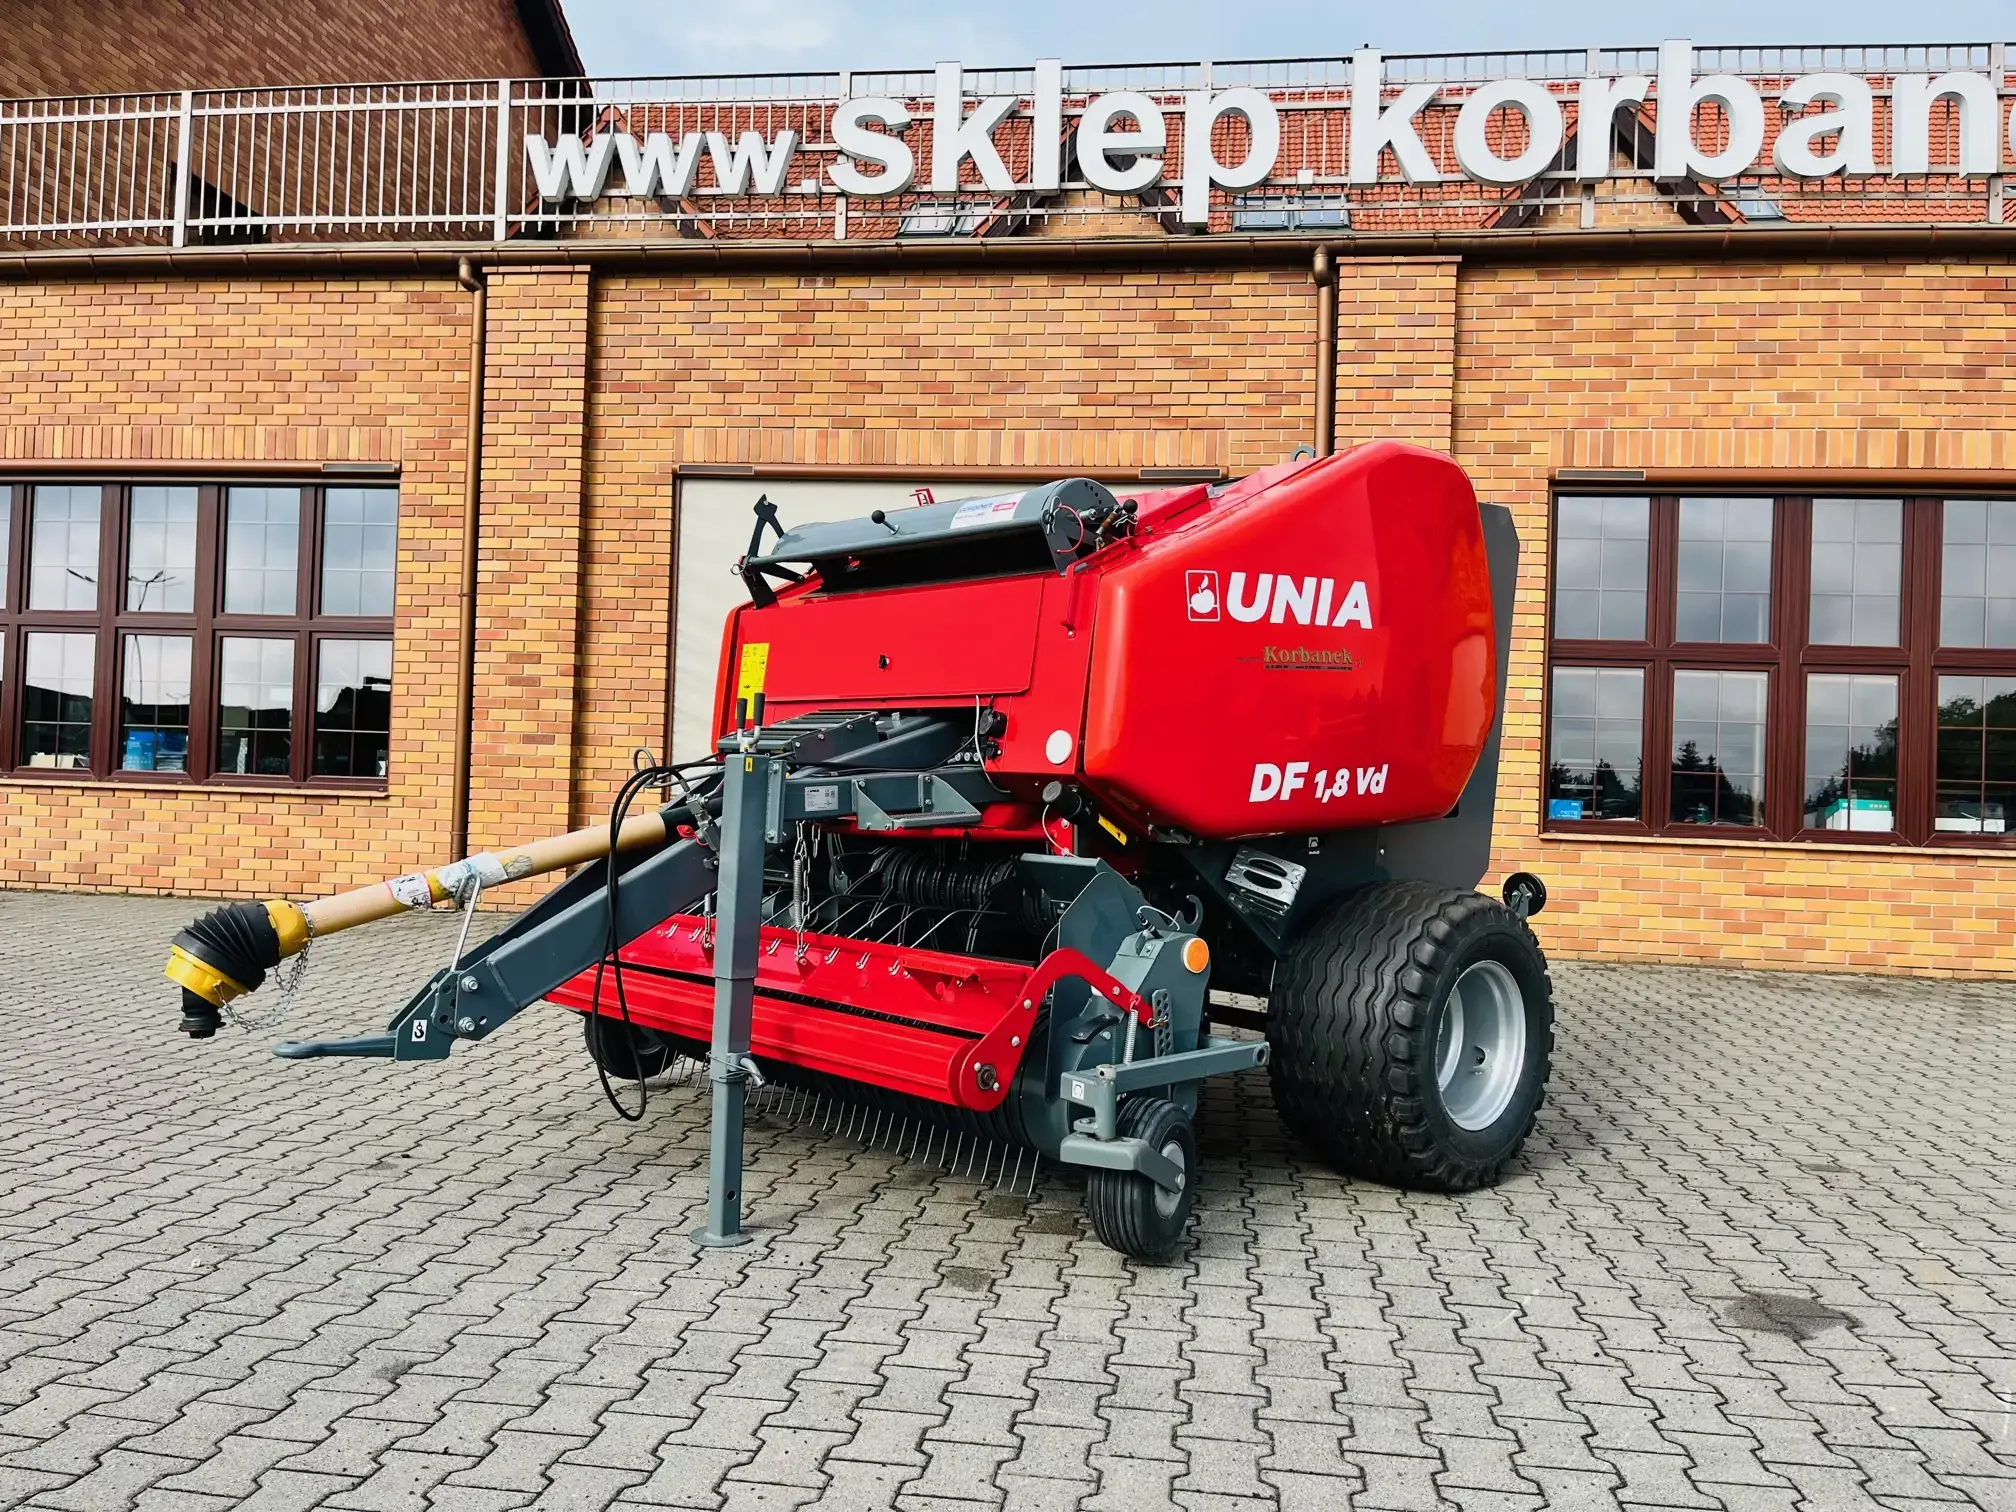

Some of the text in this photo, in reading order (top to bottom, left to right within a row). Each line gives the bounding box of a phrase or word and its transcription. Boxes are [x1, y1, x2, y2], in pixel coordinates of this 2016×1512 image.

[526, 39, 2016, 227] www.sklep.korban
[1226, 571, 1373, 629] UNIA
[1249, 761, 1388, 803] DF 1,8 Vd
